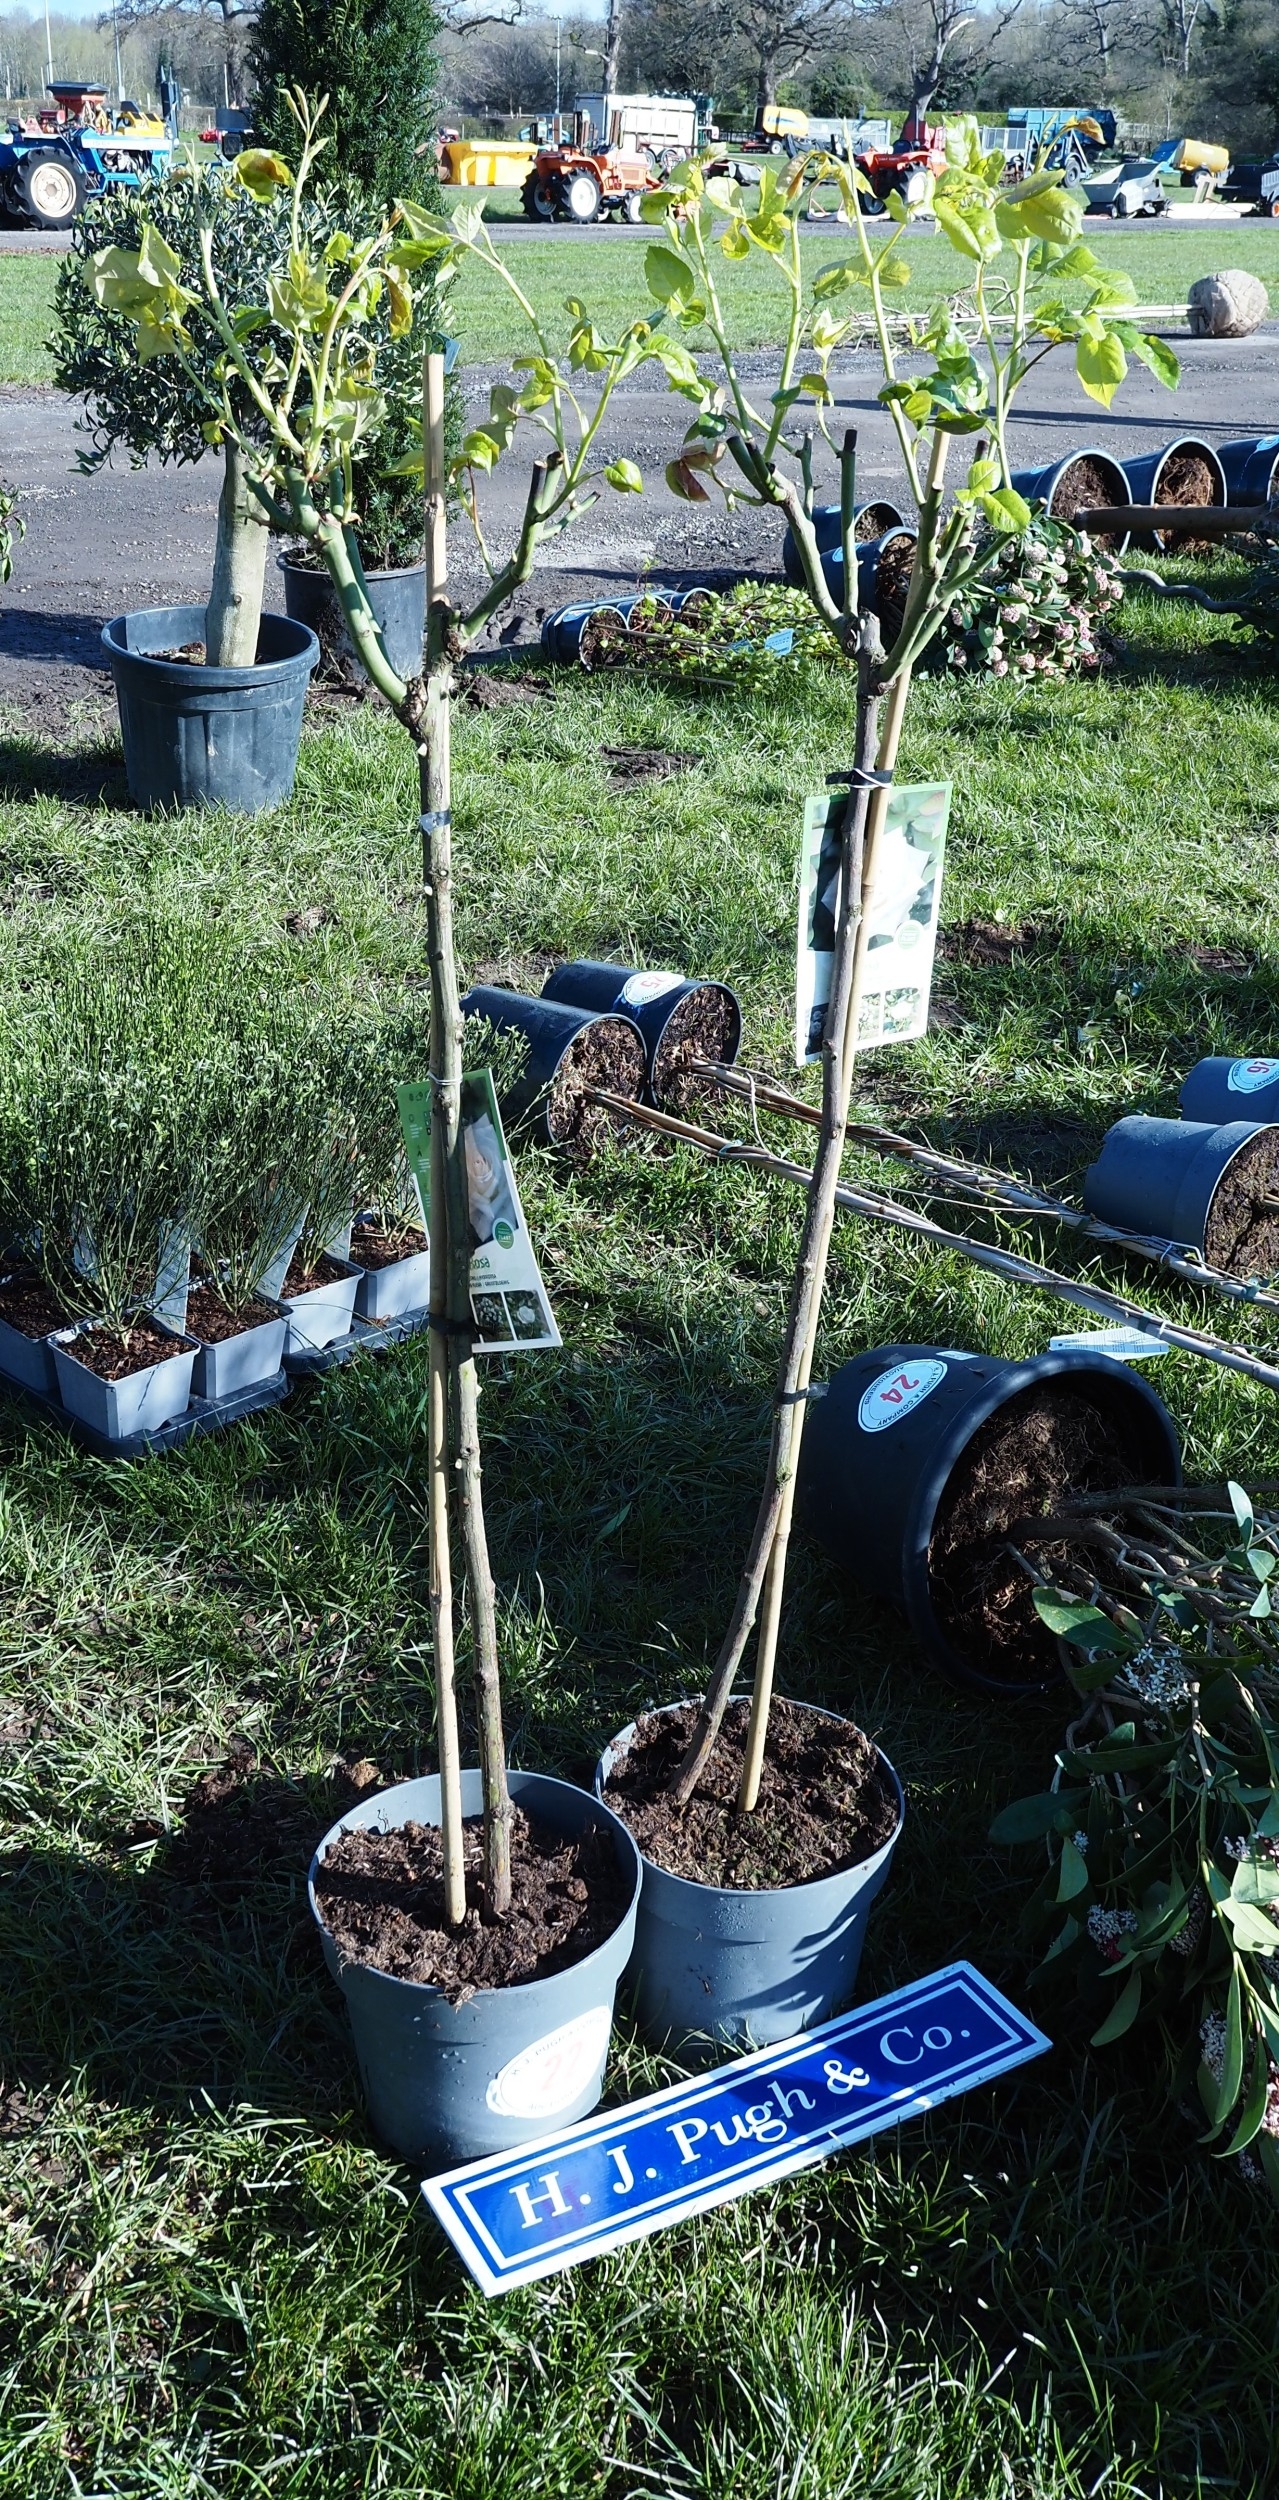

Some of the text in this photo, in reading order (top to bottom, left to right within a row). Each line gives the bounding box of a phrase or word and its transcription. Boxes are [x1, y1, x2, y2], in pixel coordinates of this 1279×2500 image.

[1247, 1061, 1277, 1073] 26
[880, 1374, 919, 1404] 24
[877, 1400, 914, 1426] COMPANY
[508, 2026, 970, 2229] H. J. Pugh & Co.
